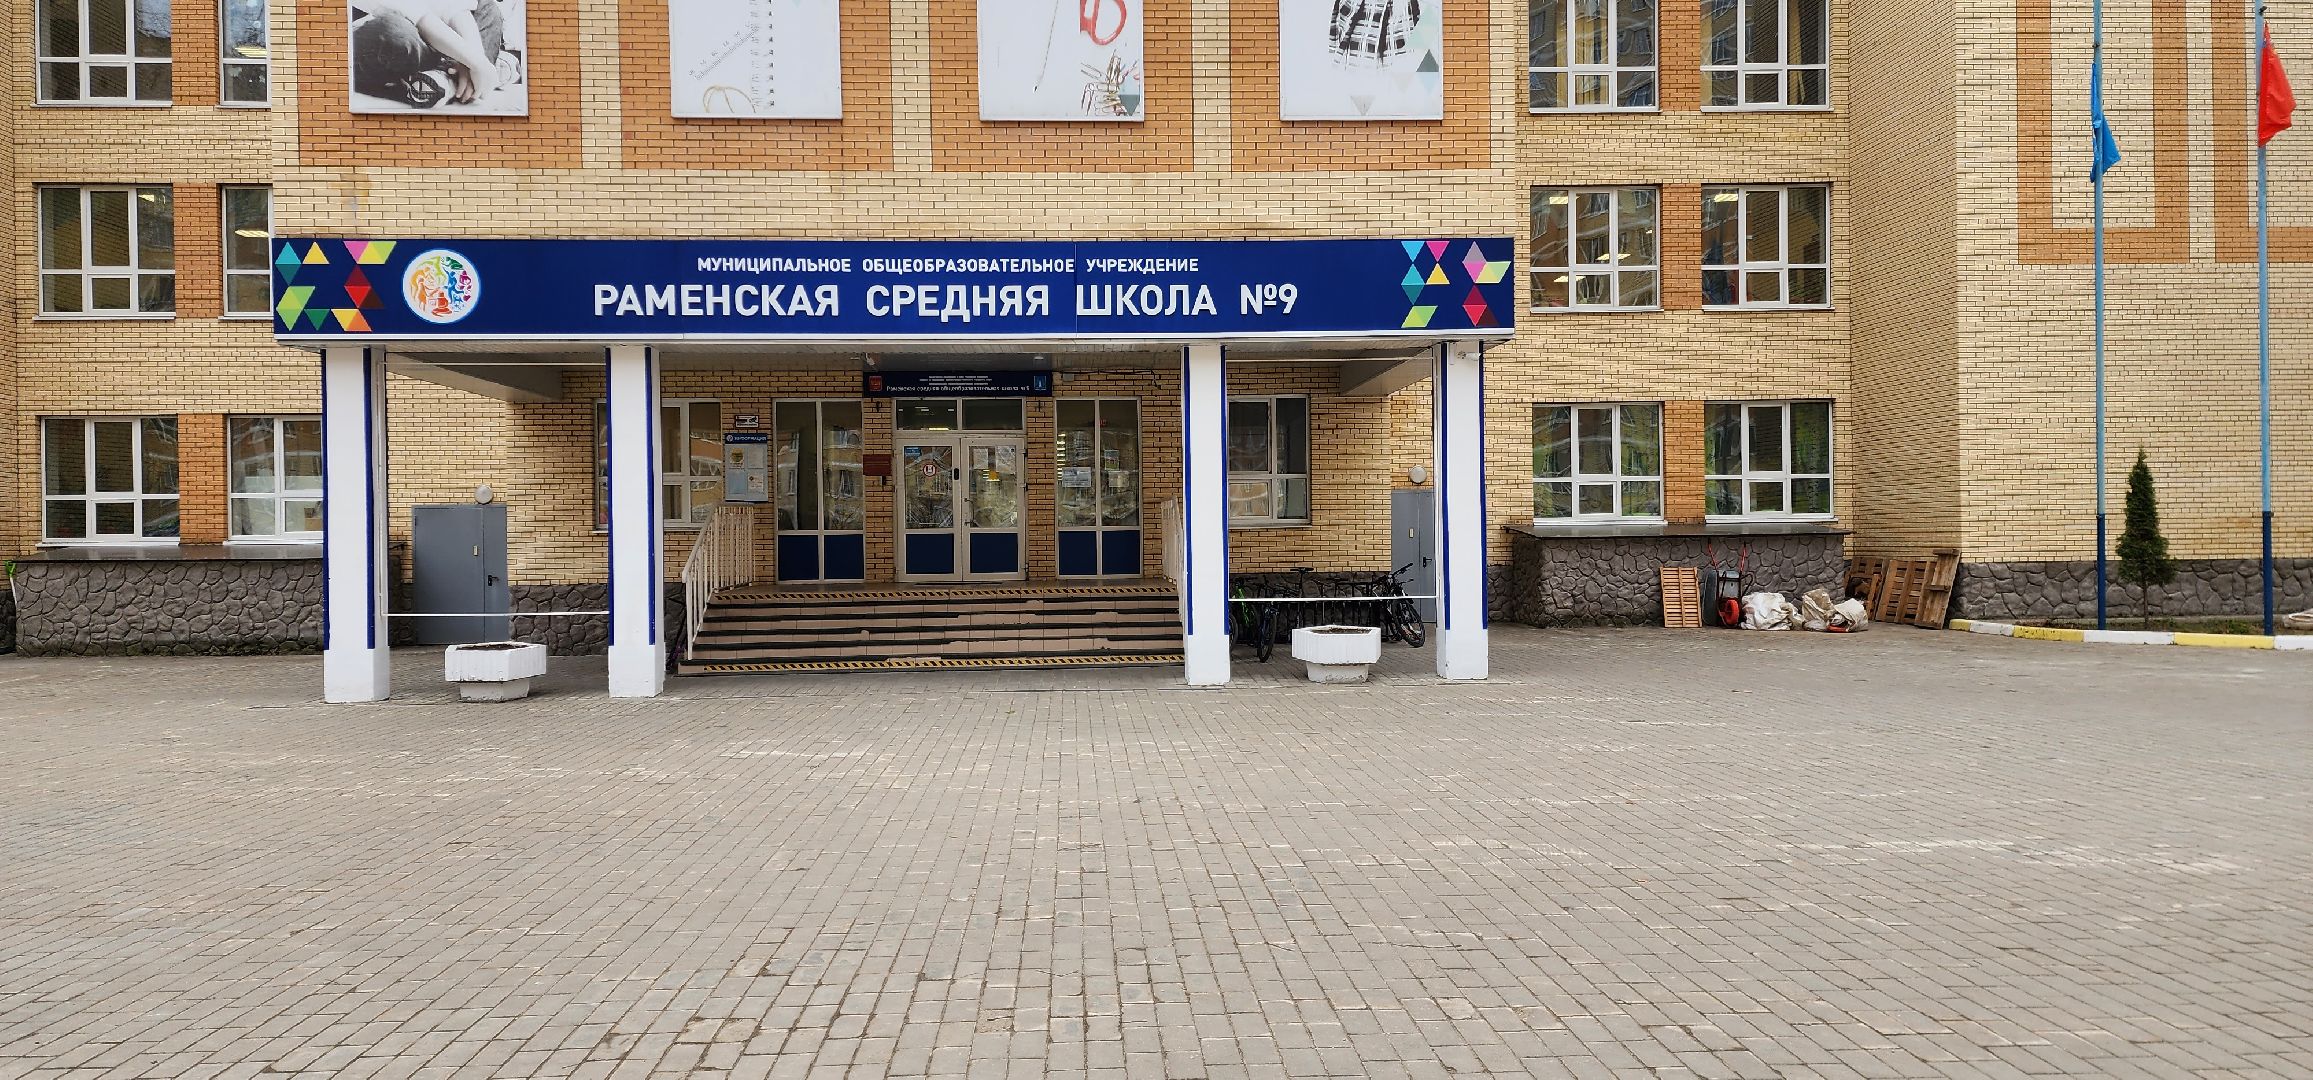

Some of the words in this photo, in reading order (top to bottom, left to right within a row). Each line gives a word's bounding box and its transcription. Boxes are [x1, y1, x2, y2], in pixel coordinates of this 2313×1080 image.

[697, 257, 852, 275] МУНИЦИПАЛЬНОЕ
[862, 257, 1075, 275] ОБЩЕОБРАЗОВАТЕЛЬНОЕ
[1085, 258, 1199, 275] УЧРЕЖДЕНИЕ
[594, 284, 839, 317] РАМЕНСКАЯ
[866, 284, 1049, 323] СРЕДНЯЯ
[1076, 284, 1218, 316] ШКОЛА
[1240, 283, 1298, 315] №9
